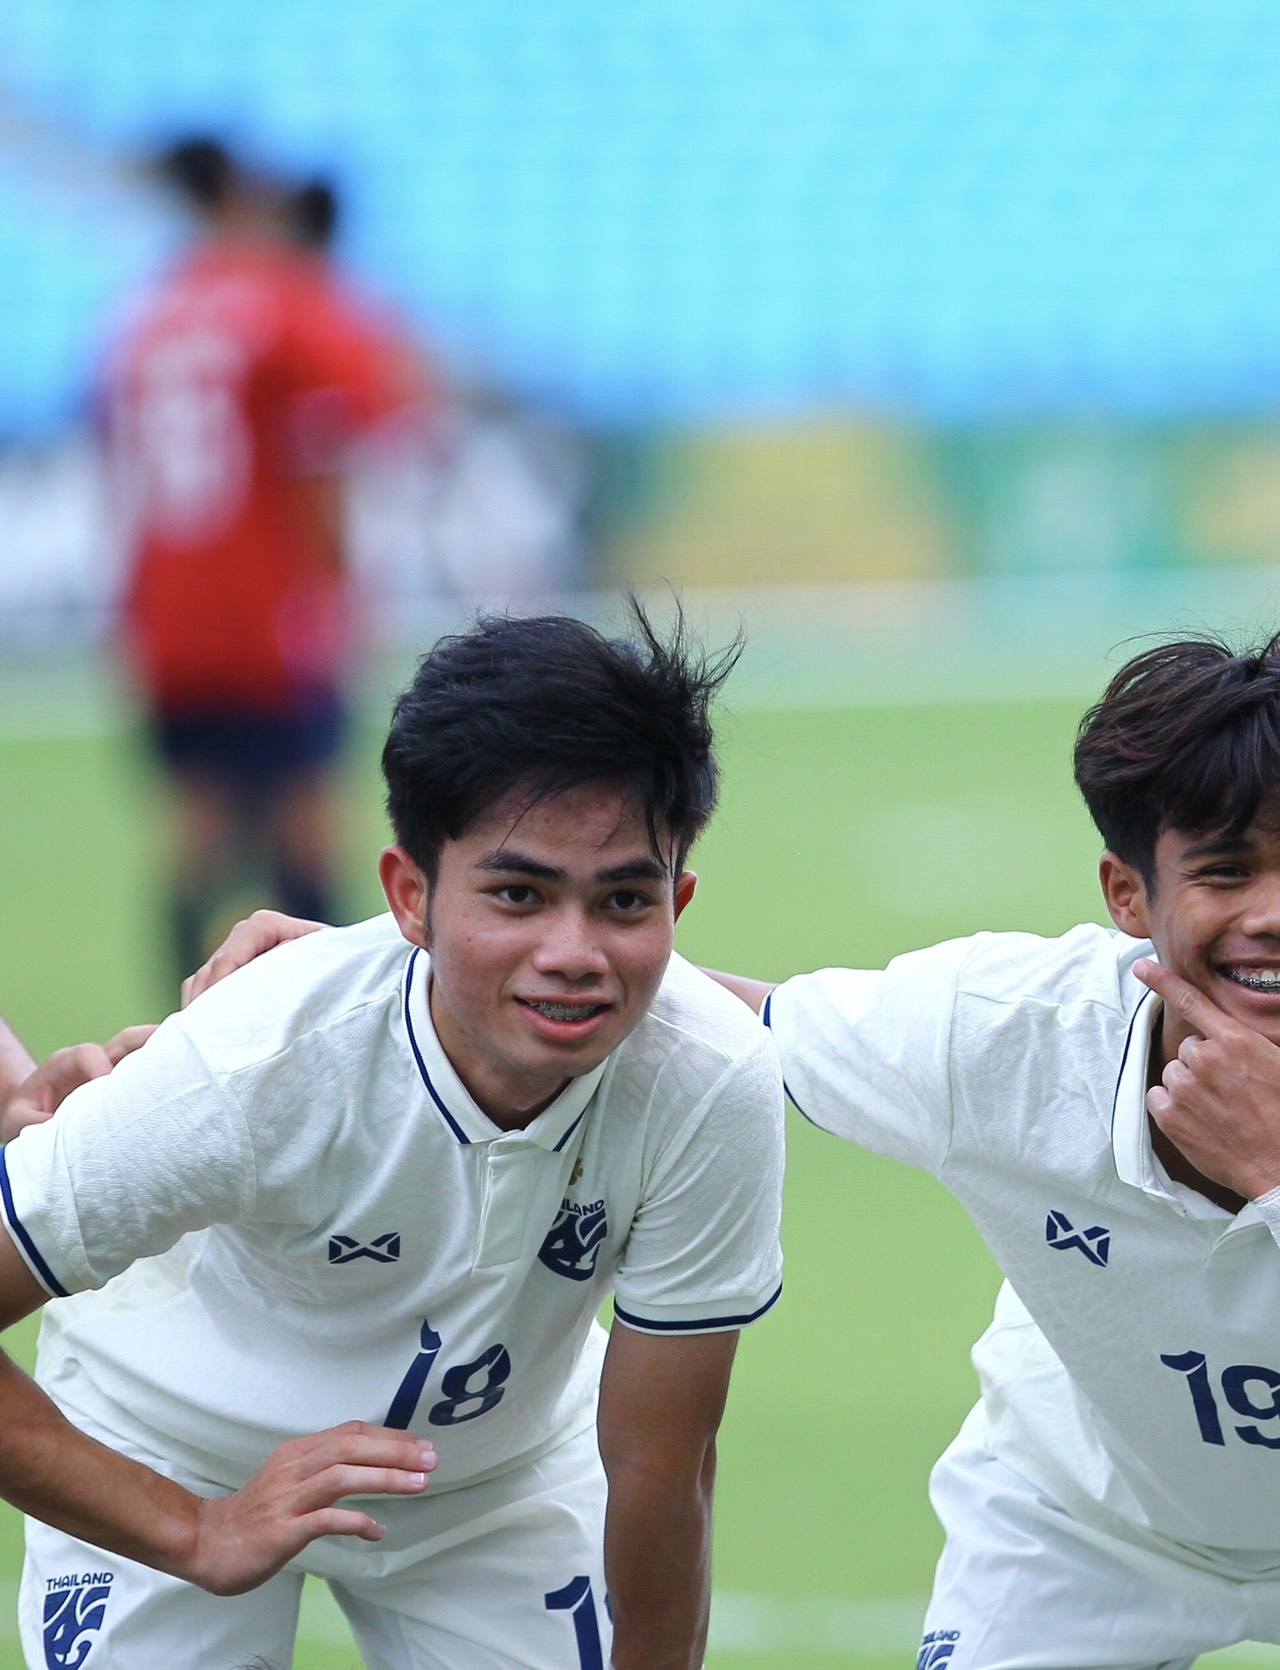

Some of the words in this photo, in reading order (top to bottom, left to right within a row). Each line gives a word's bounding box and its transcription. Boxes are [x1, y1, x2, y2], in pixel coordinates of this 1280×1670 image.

[561, 1198, 605, 1216] ILAND
[382, 1318, 511, 1430] 18
[46, 1572, 114, 1591] THAILAND
[544, 1576, 614, 1670] 1
